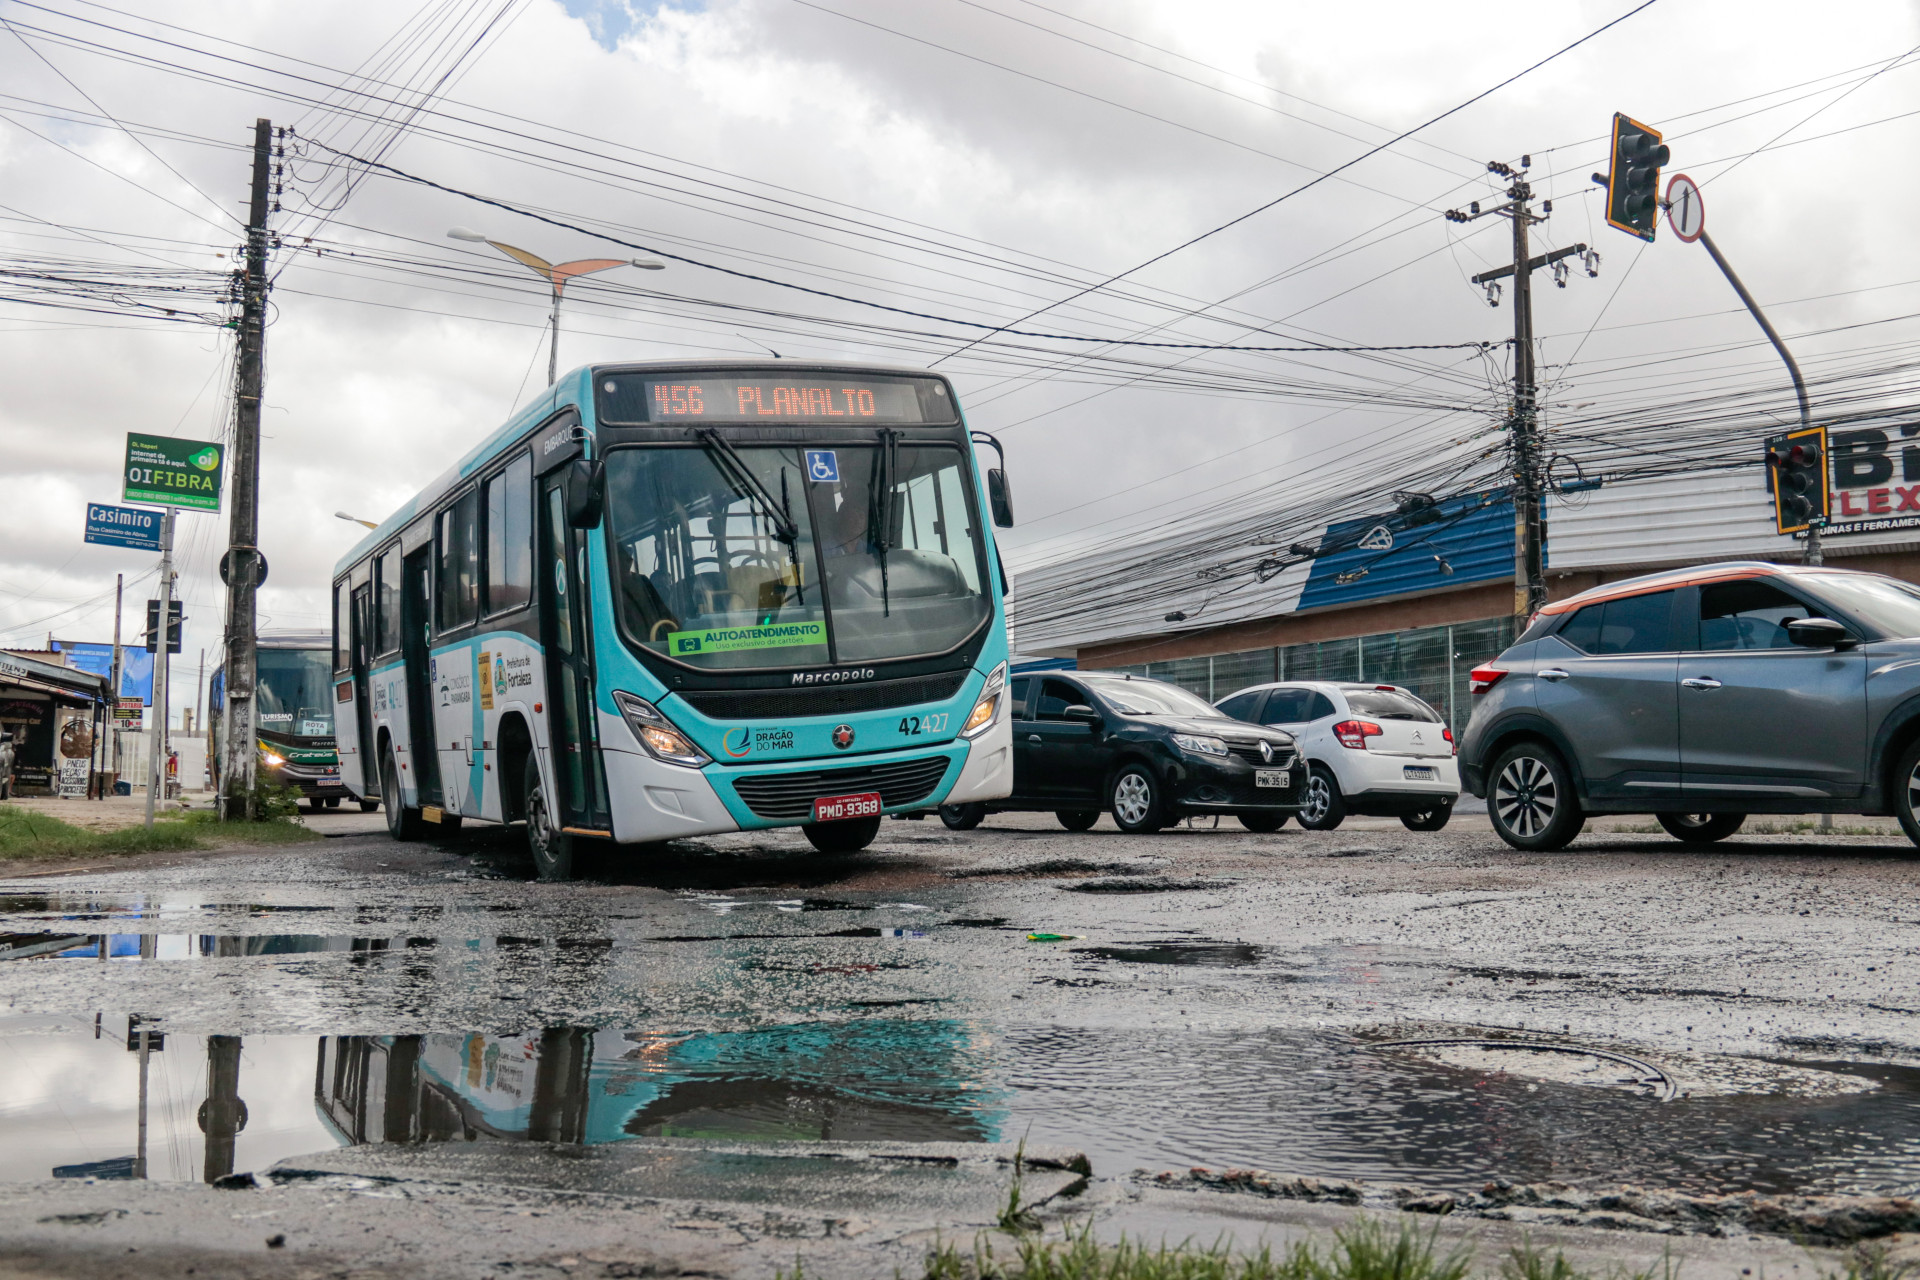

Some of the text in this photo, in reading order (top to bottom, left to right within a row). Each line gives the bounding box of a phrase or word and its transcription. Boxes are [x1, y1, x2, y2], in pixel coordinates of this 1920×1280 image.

[654, 385, 875, 416] 456 PLANALTO
[544, 424, 573, 455] EMBARQUE
[130, 456, 157, 464] primeira
[198, 452, 212, 466] oi
[90, 506, 152, 528] Casimiro
[100, 527, 124, 535] Casimiro
[704, 624, 820, 643] AUTOATENDIMENTO
[731, 639, 765, 649] exclusivo
[767, 638, 777, 647] de
[778, 636, 804, 645] cartões
[506, 655, 530, 669] Prefeitura de
[507, 670, 532, 688] Fortaleza
[792, 668, 875, 684] Marcopolo
[260, 713, 293, 722] TURISMO
[898, 712, 949, 736] 42427
[756, 729, 794, 741] DRAGÃO
[756, 740, 794, 751] DO MAR
[66, 760, 86, 768] PNEUS
